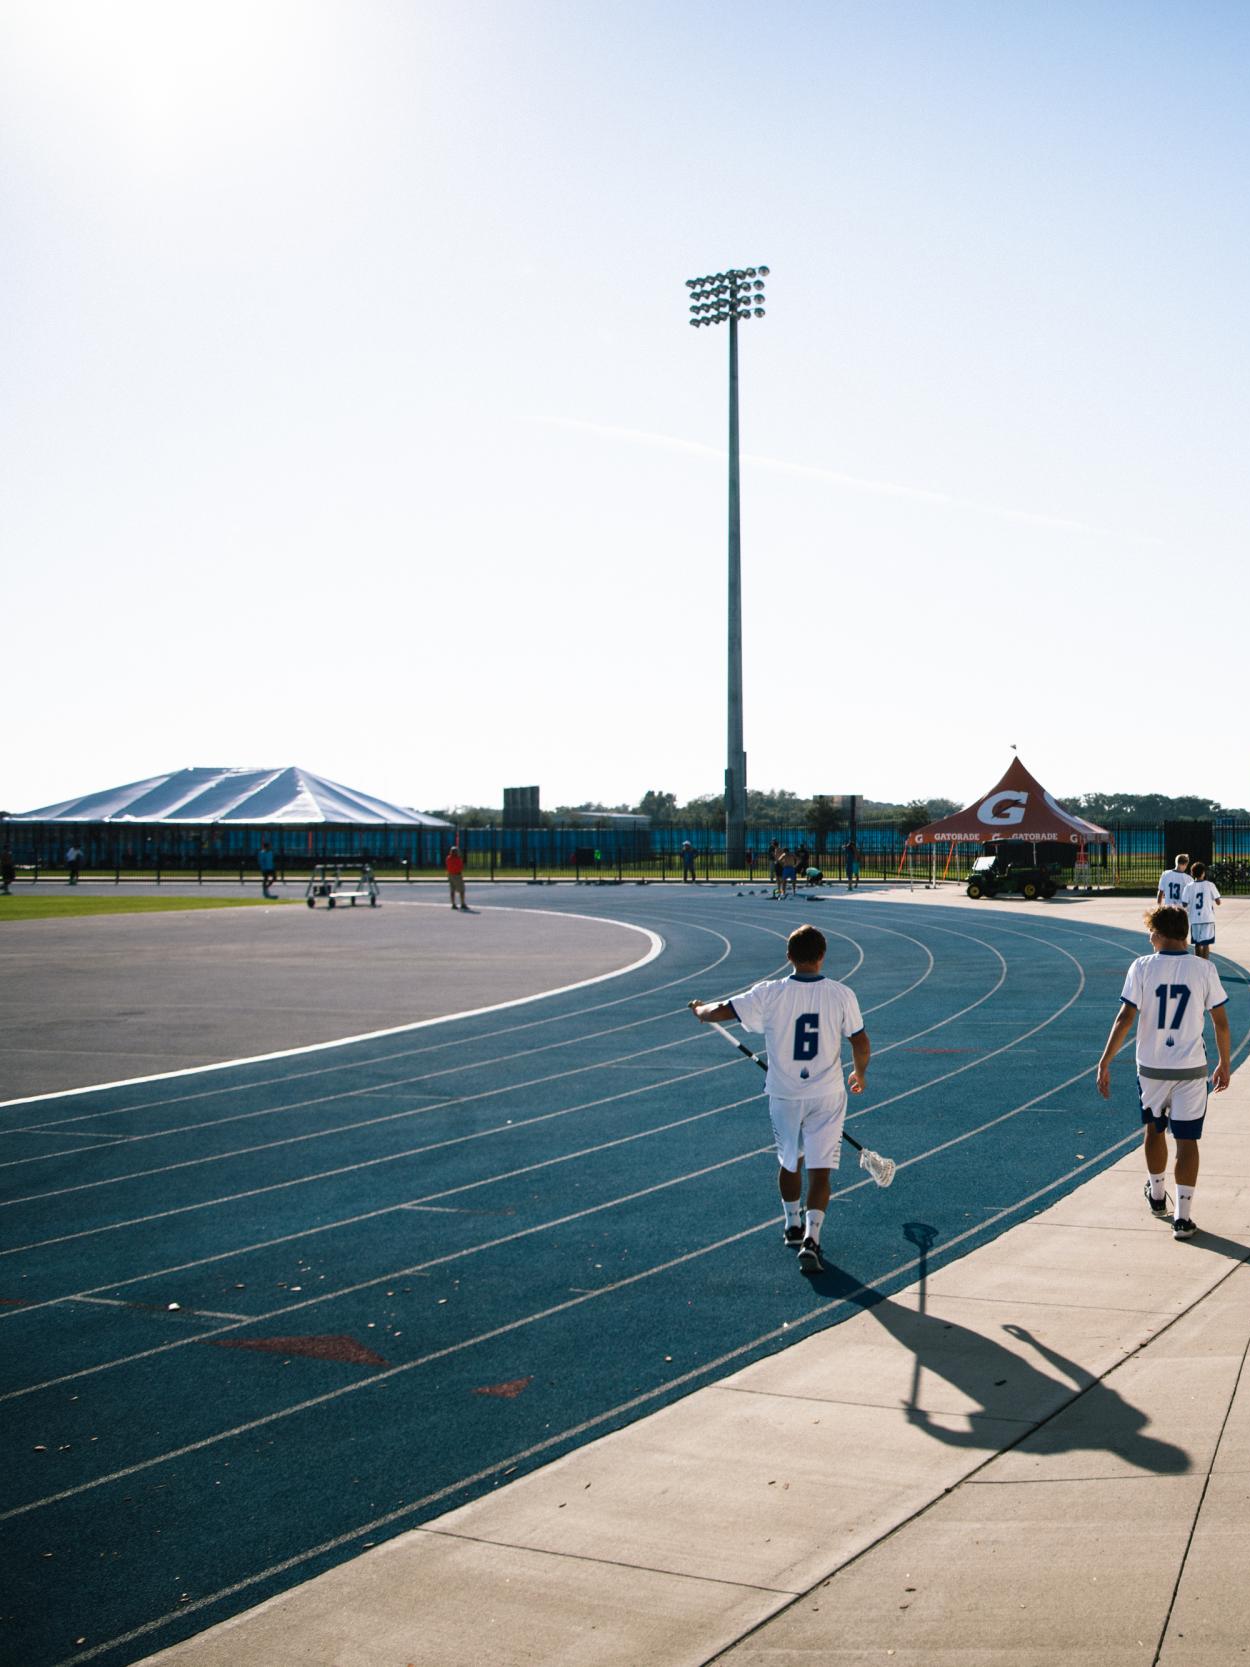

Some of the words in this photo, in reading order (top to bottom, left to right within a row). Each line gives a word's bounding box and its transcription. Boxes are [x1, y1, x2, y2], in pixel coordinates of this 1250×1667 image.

[977, 790, 1029, 826] G
[914, 833, 924, 844] G
[934, 832, 980, 841] GATORADE
[1012, 832, 1058, 841] GATORADE
[1070, 833, 1078, 843] G
[1168, 882, 1181, 900] 13
[1196, 892, 1204, 910] 3
[1155, 984, 1191, 1029] 17
[793, 1013, 819, 1060] 6
